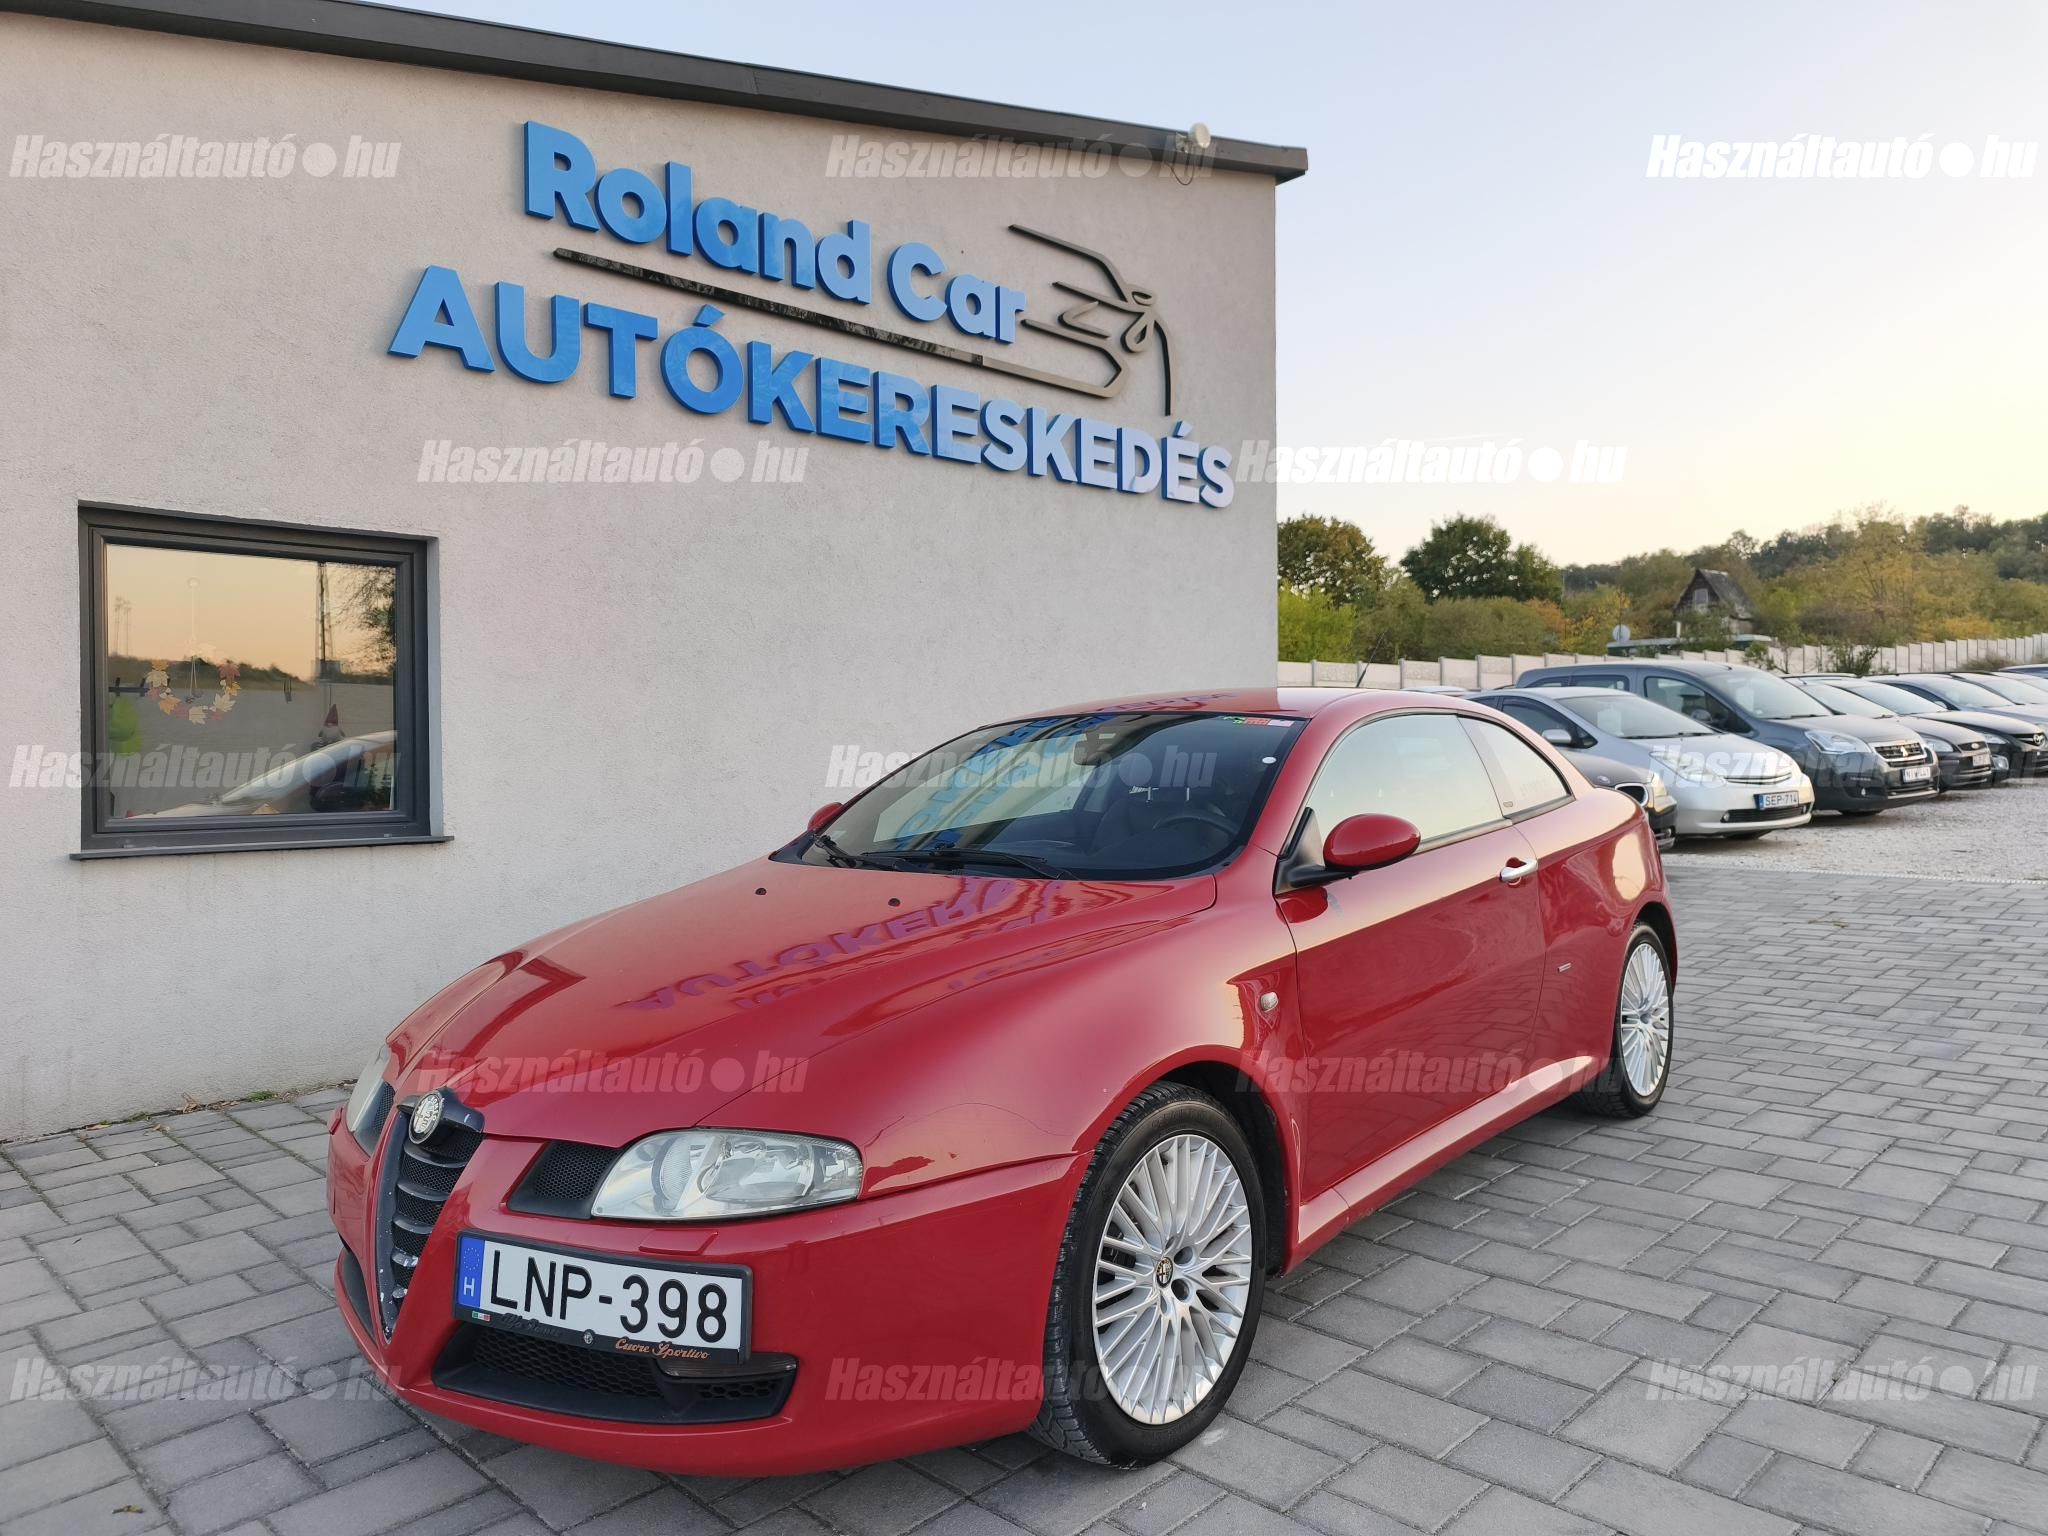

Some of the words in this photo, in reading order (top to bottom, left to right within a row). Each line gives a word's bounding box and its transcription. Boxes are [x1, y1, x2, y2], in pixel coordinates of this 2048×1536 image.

[524, 120, 870, 306] Roland
[887, 242, 1026, 345] Car
[387, 264, 1235, 509] AUTÓKERESKEDÉS
[463, 1277, 475, 1297] H
[490, 1250, 727, 1343] LNP-398
[615, 1338, 650, 1354] Cuore
[652, 1343, 709, 1360] Sportivo
